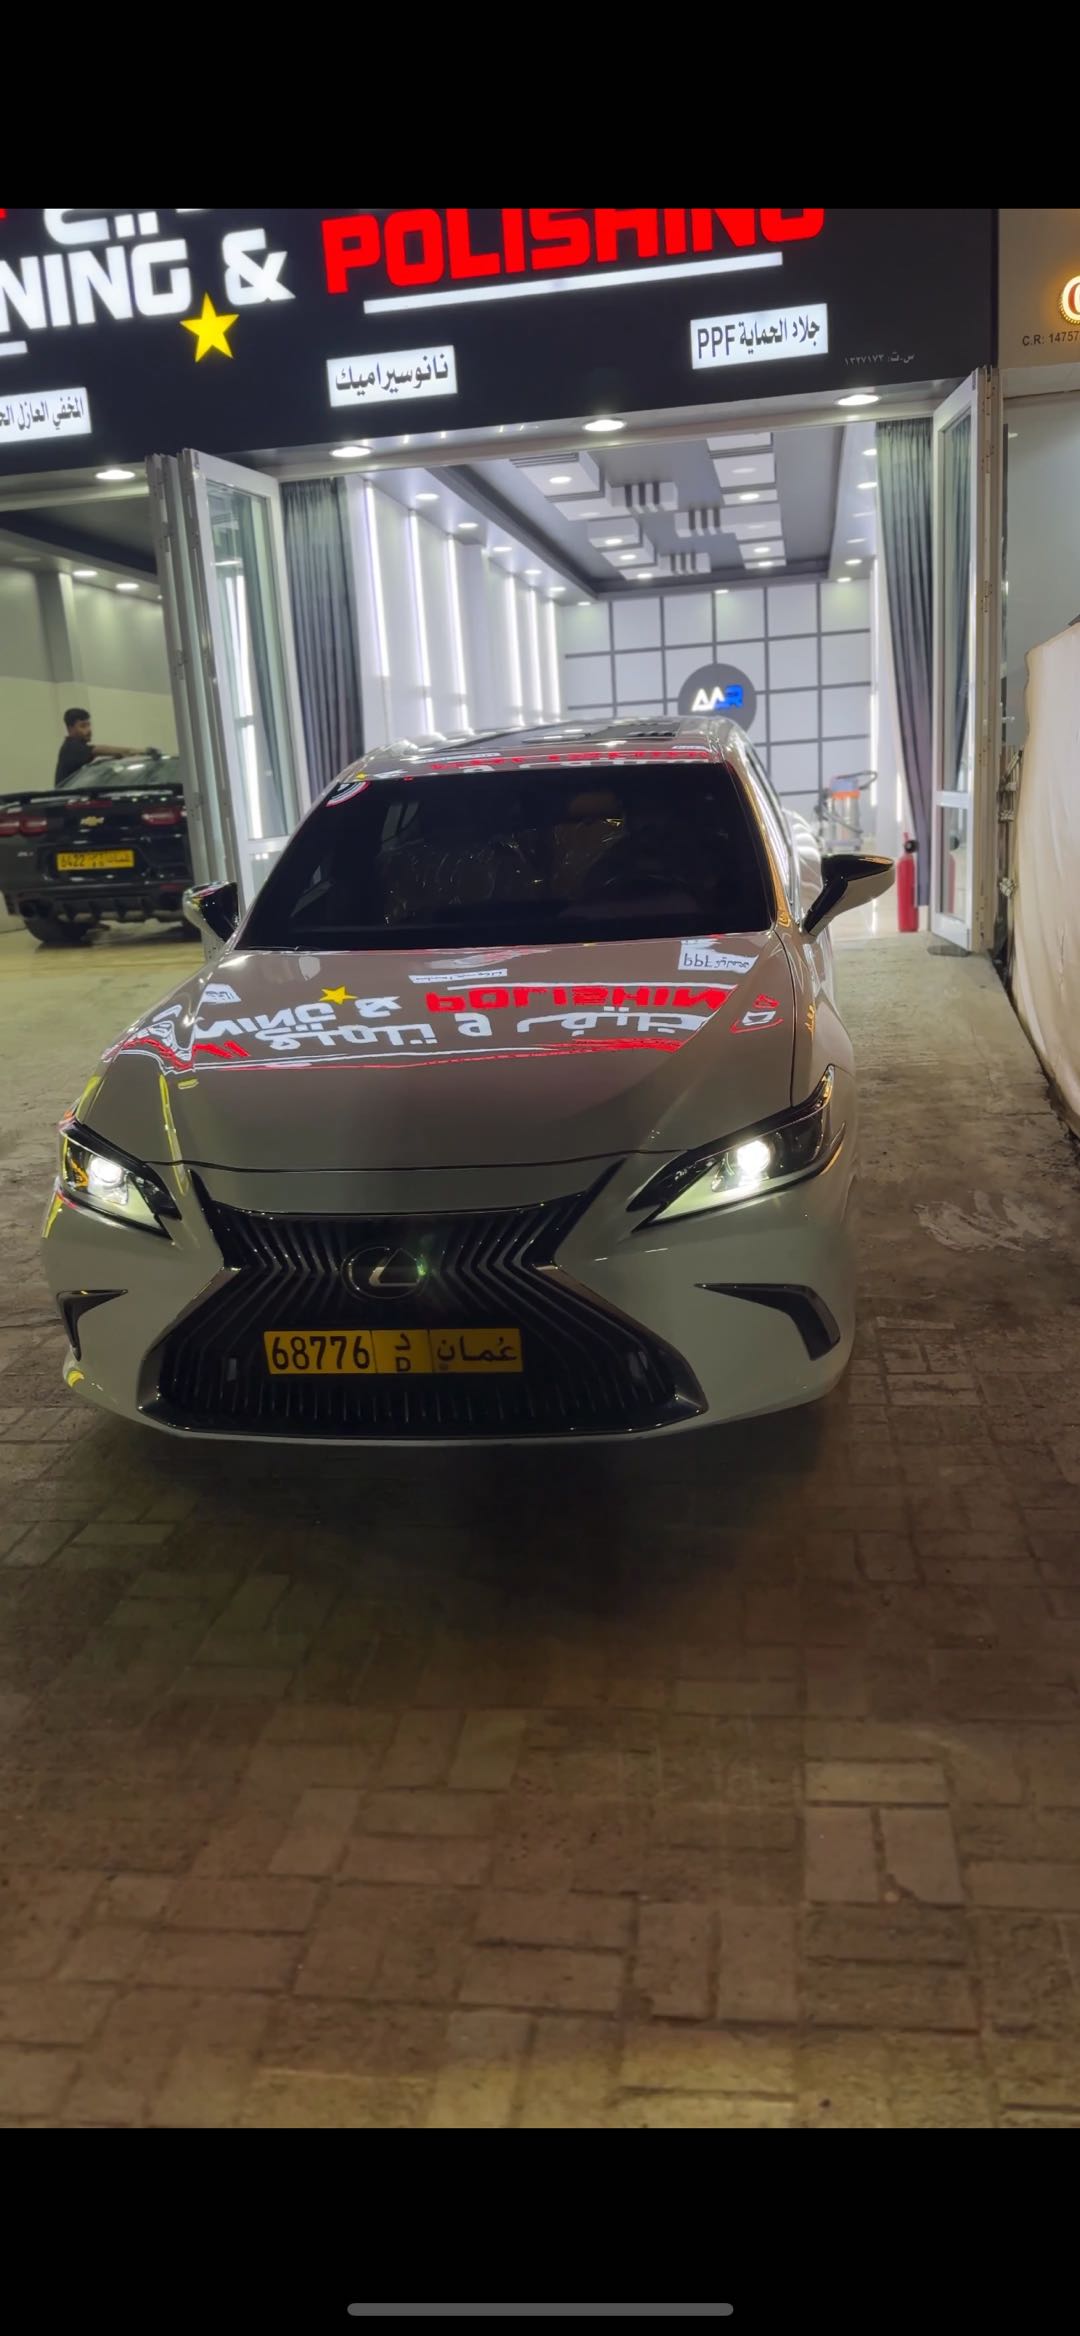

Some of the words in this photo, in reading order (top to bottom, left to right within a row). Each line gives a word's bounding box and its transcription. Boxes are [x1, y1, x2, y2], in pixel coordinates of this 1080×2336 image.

[221, 228, 296, 306] &
[697, 324, 736, 359] PPF
[739, 317, 788, 355] الحماية
[272, 1335, 371, 1370] 68776
[395, 1356, 412, 1372] D
